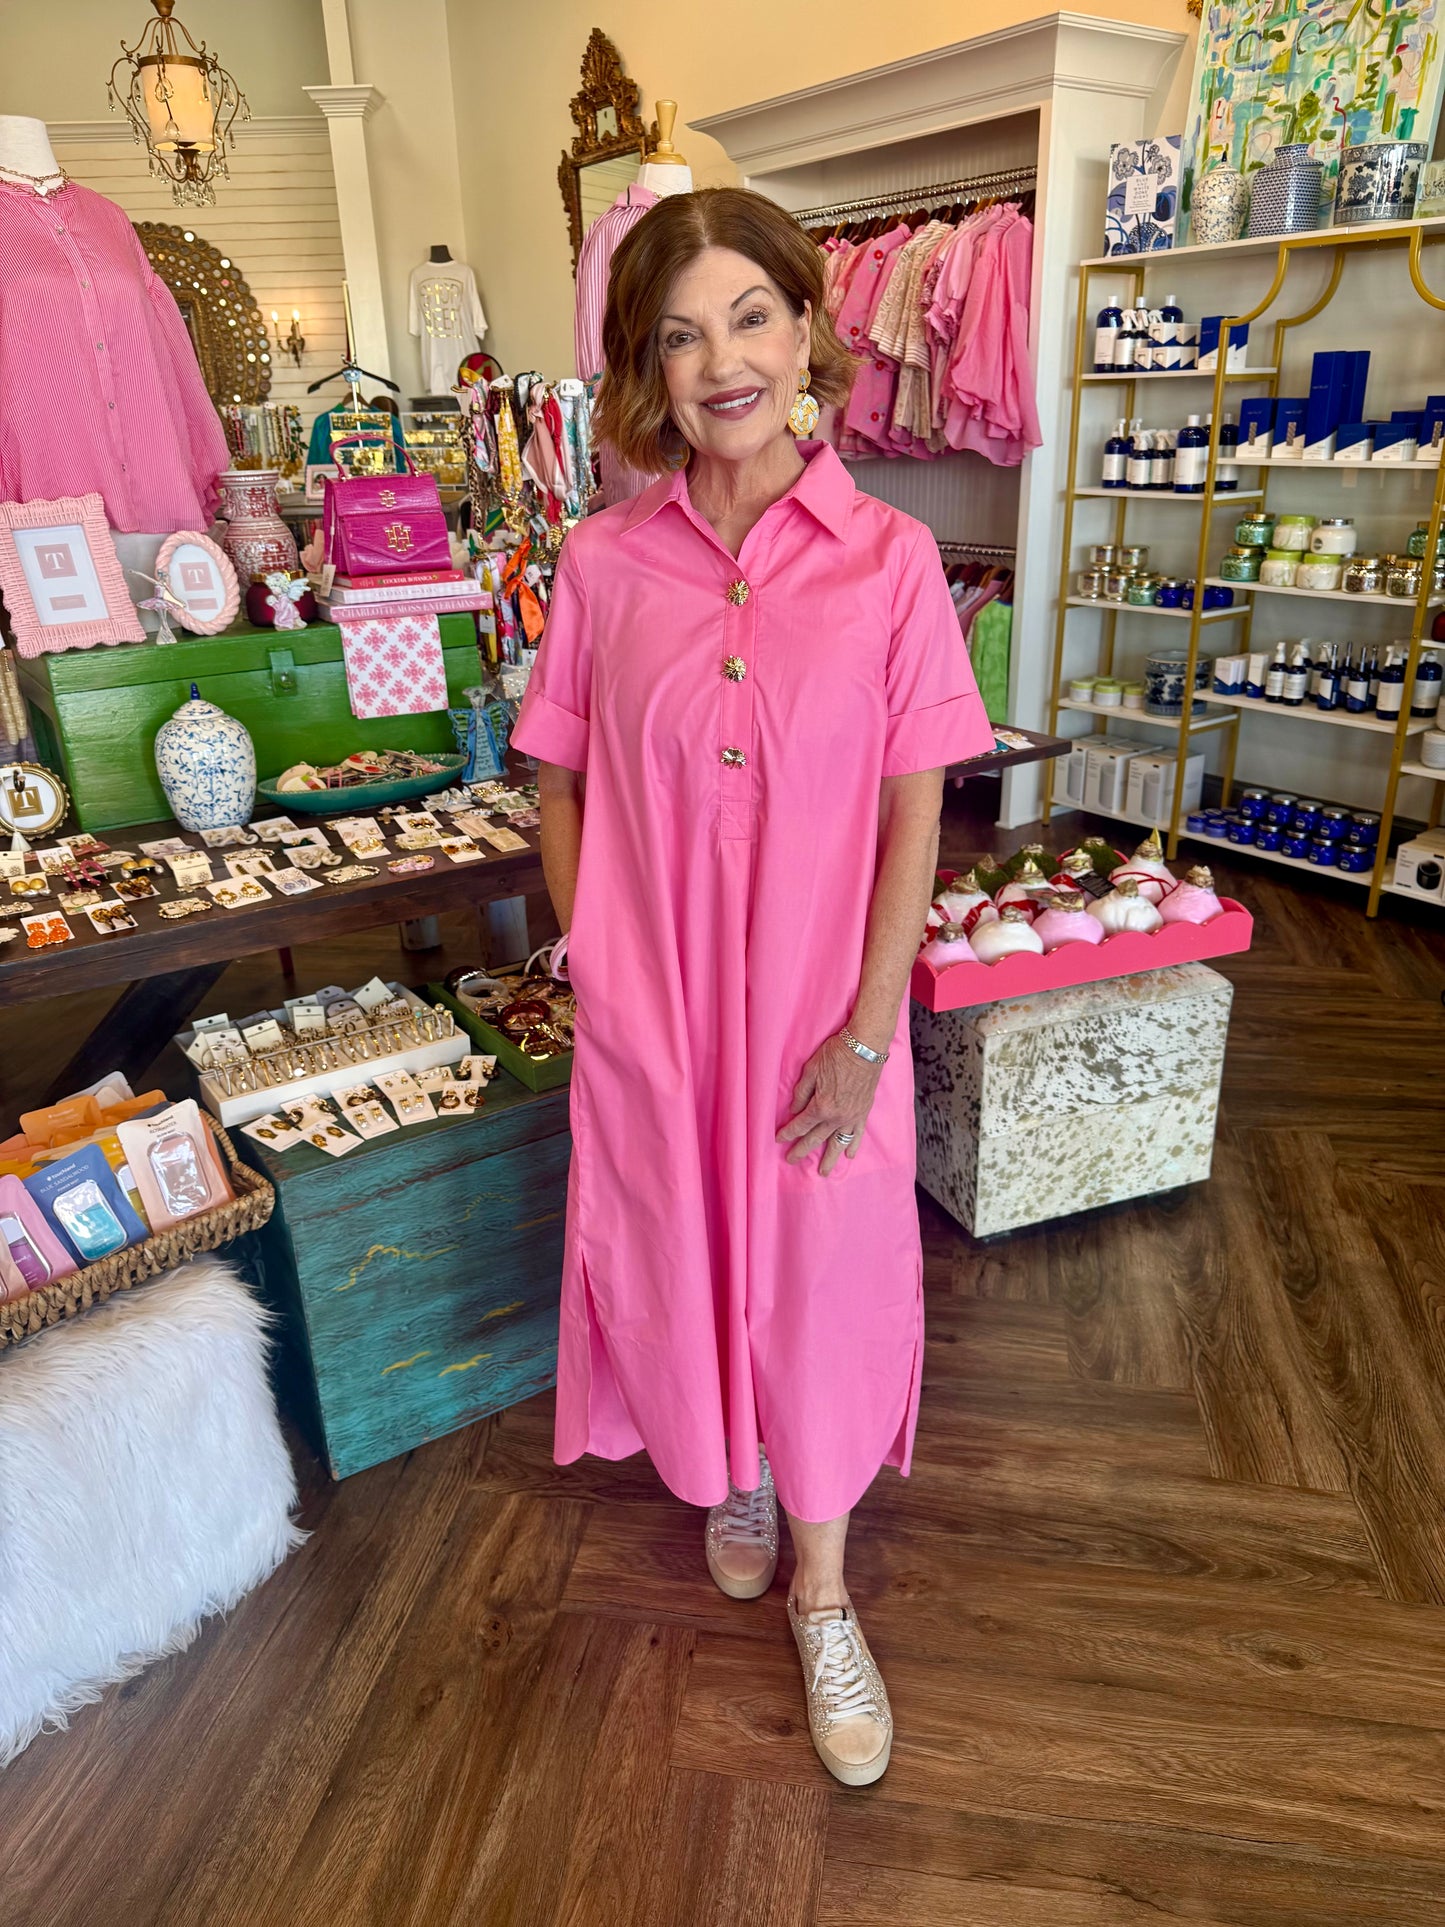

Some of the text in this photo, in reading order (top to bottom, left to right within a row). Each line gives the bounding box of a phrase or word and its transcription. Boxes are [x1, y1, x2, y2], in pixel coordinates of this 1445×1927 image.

[45, 552, 65, 570] T
[187, 568, 204, 584] T
[341, 599, 475, 618] CHARLOTTE MOSS ENTERTAINS
[14, 790, 35, 809] T
[51, 1163, 76, 1179] touchland
